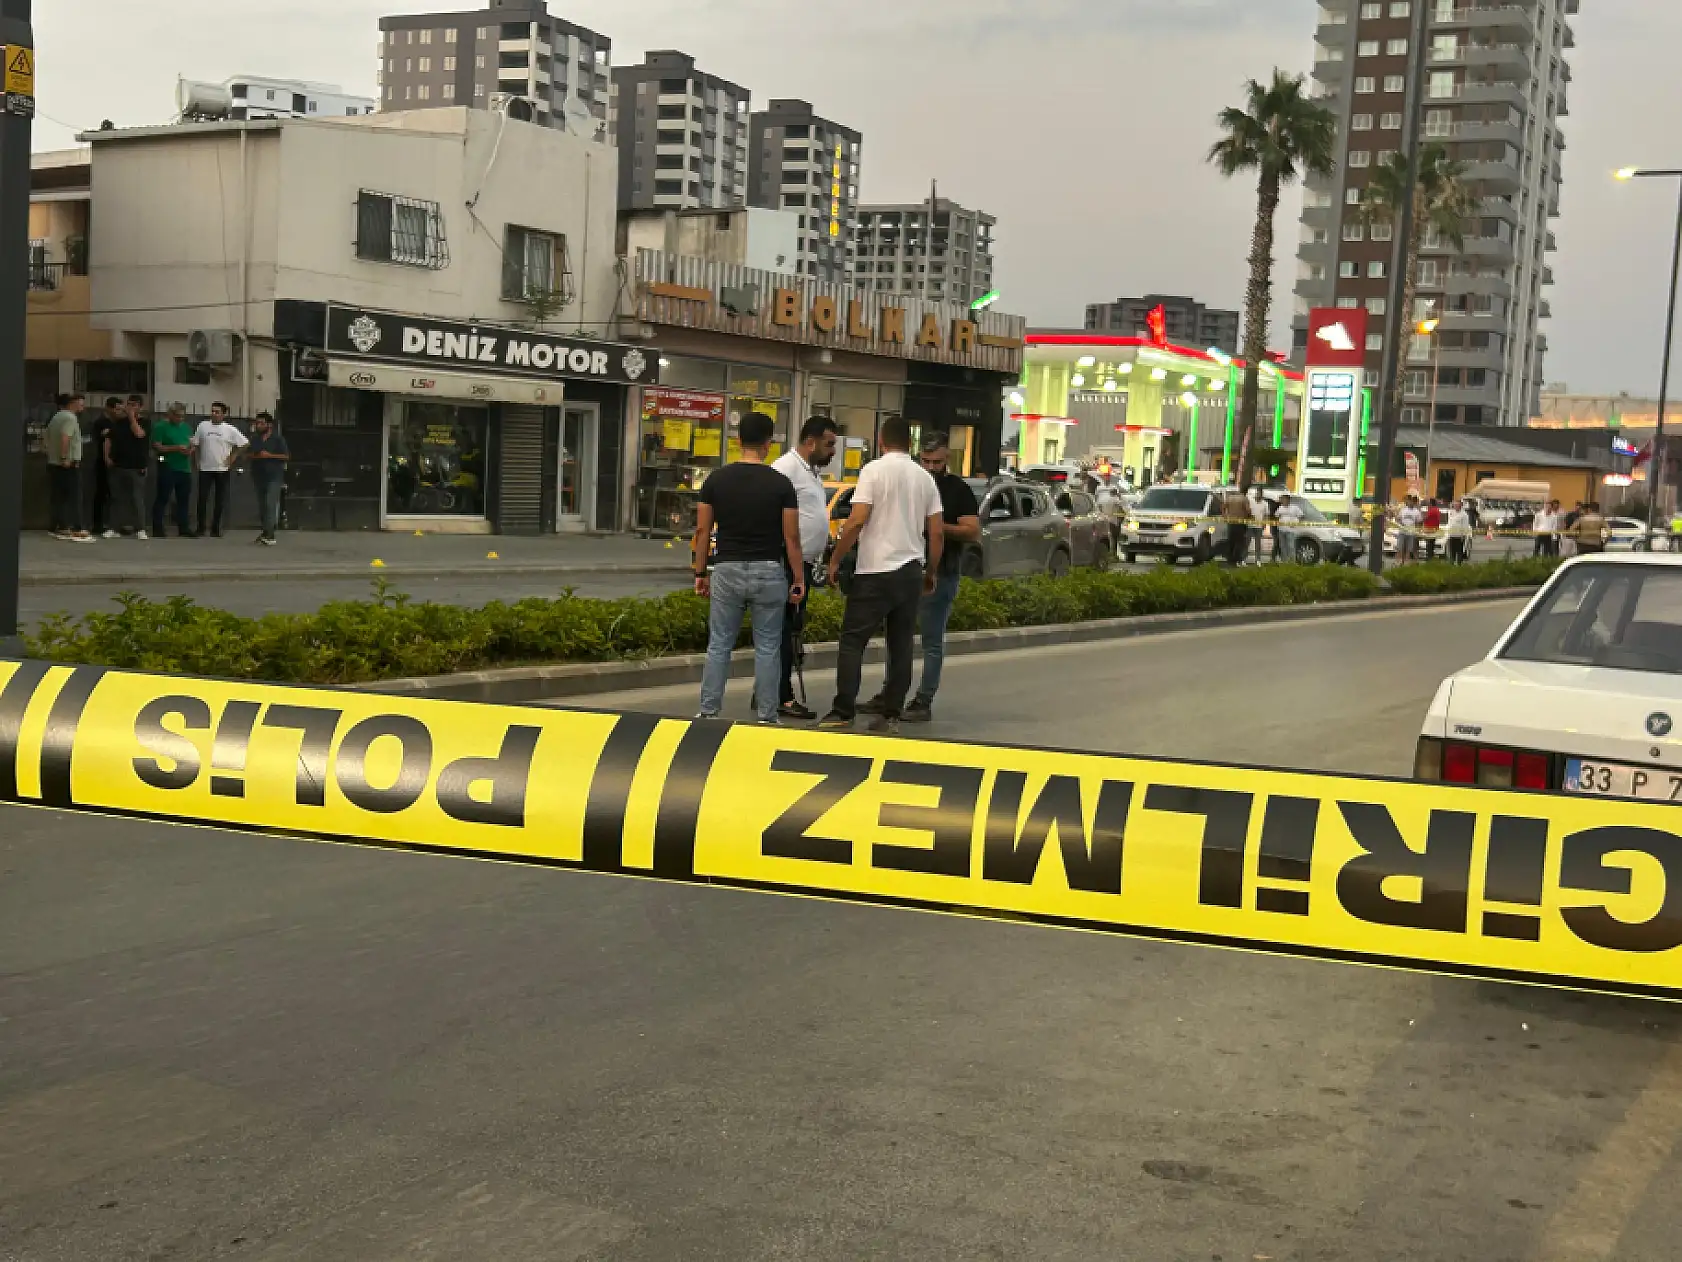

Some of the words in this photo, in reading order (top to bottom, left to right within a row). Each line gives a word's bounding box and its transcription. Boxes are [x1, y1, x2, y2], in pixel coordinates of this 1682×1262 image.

[402, 327, 498, 362] DENİZ
[506, 340, 608, 374] MOTOR
[774, 288, 974, 352] BOLKAR
[132, 694, 544, 828] POLİS
[1580, 764, 1612, 791] 33
[1631, 770, 1648, 796] P
[762, 749, 1682, 953] GİRİLMEZ
